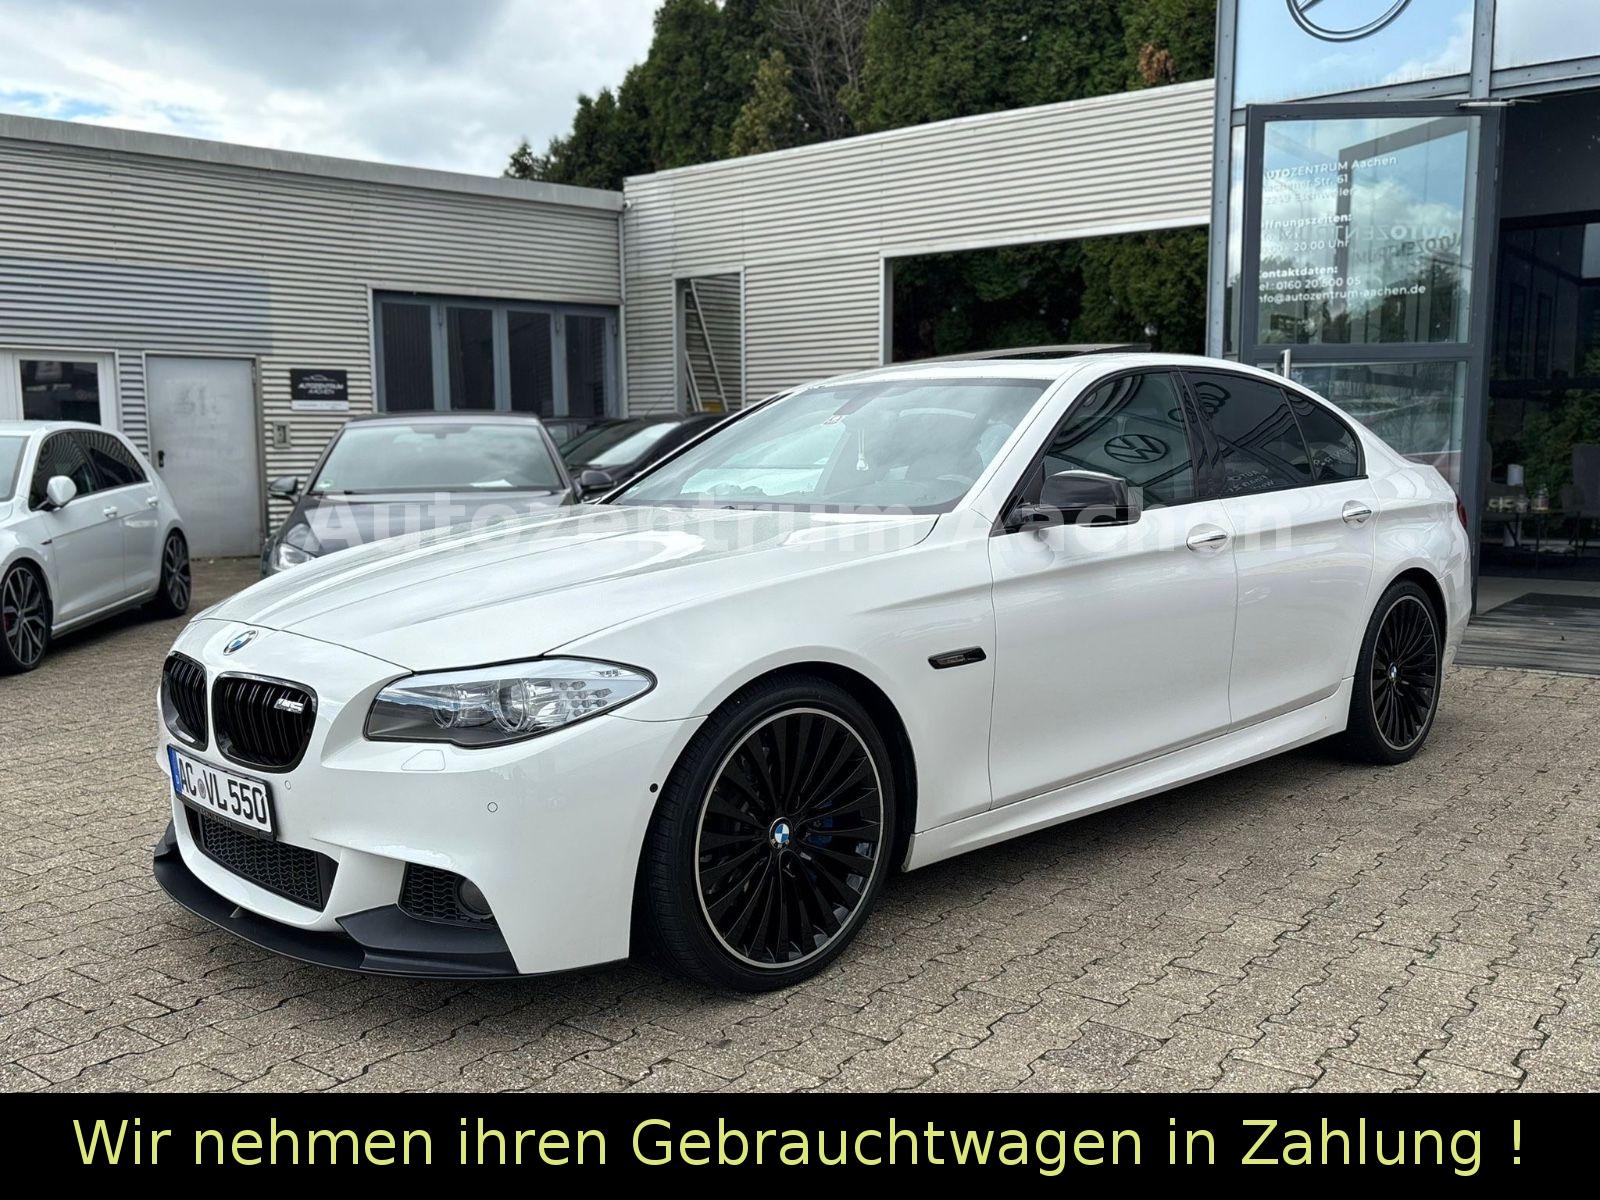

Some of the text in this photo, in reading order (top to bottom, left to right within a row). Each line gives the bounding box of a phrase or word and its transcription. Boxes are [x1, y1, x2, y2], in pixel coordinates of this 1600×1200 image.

[1350, 155, 1397, 170] Aachen
[1328, 238, 1350, 248] Uhr
[1259, 282, 1275, 292] el.:
[1276, 279, 1301, 290] 0160
[1259, 283, 1427, 305] nfo@autozentrum-aachen.de
[178, 757, 197, 797] AC
[202, 769, 228, 811] VL
[227, 778, 267, 825] 550
